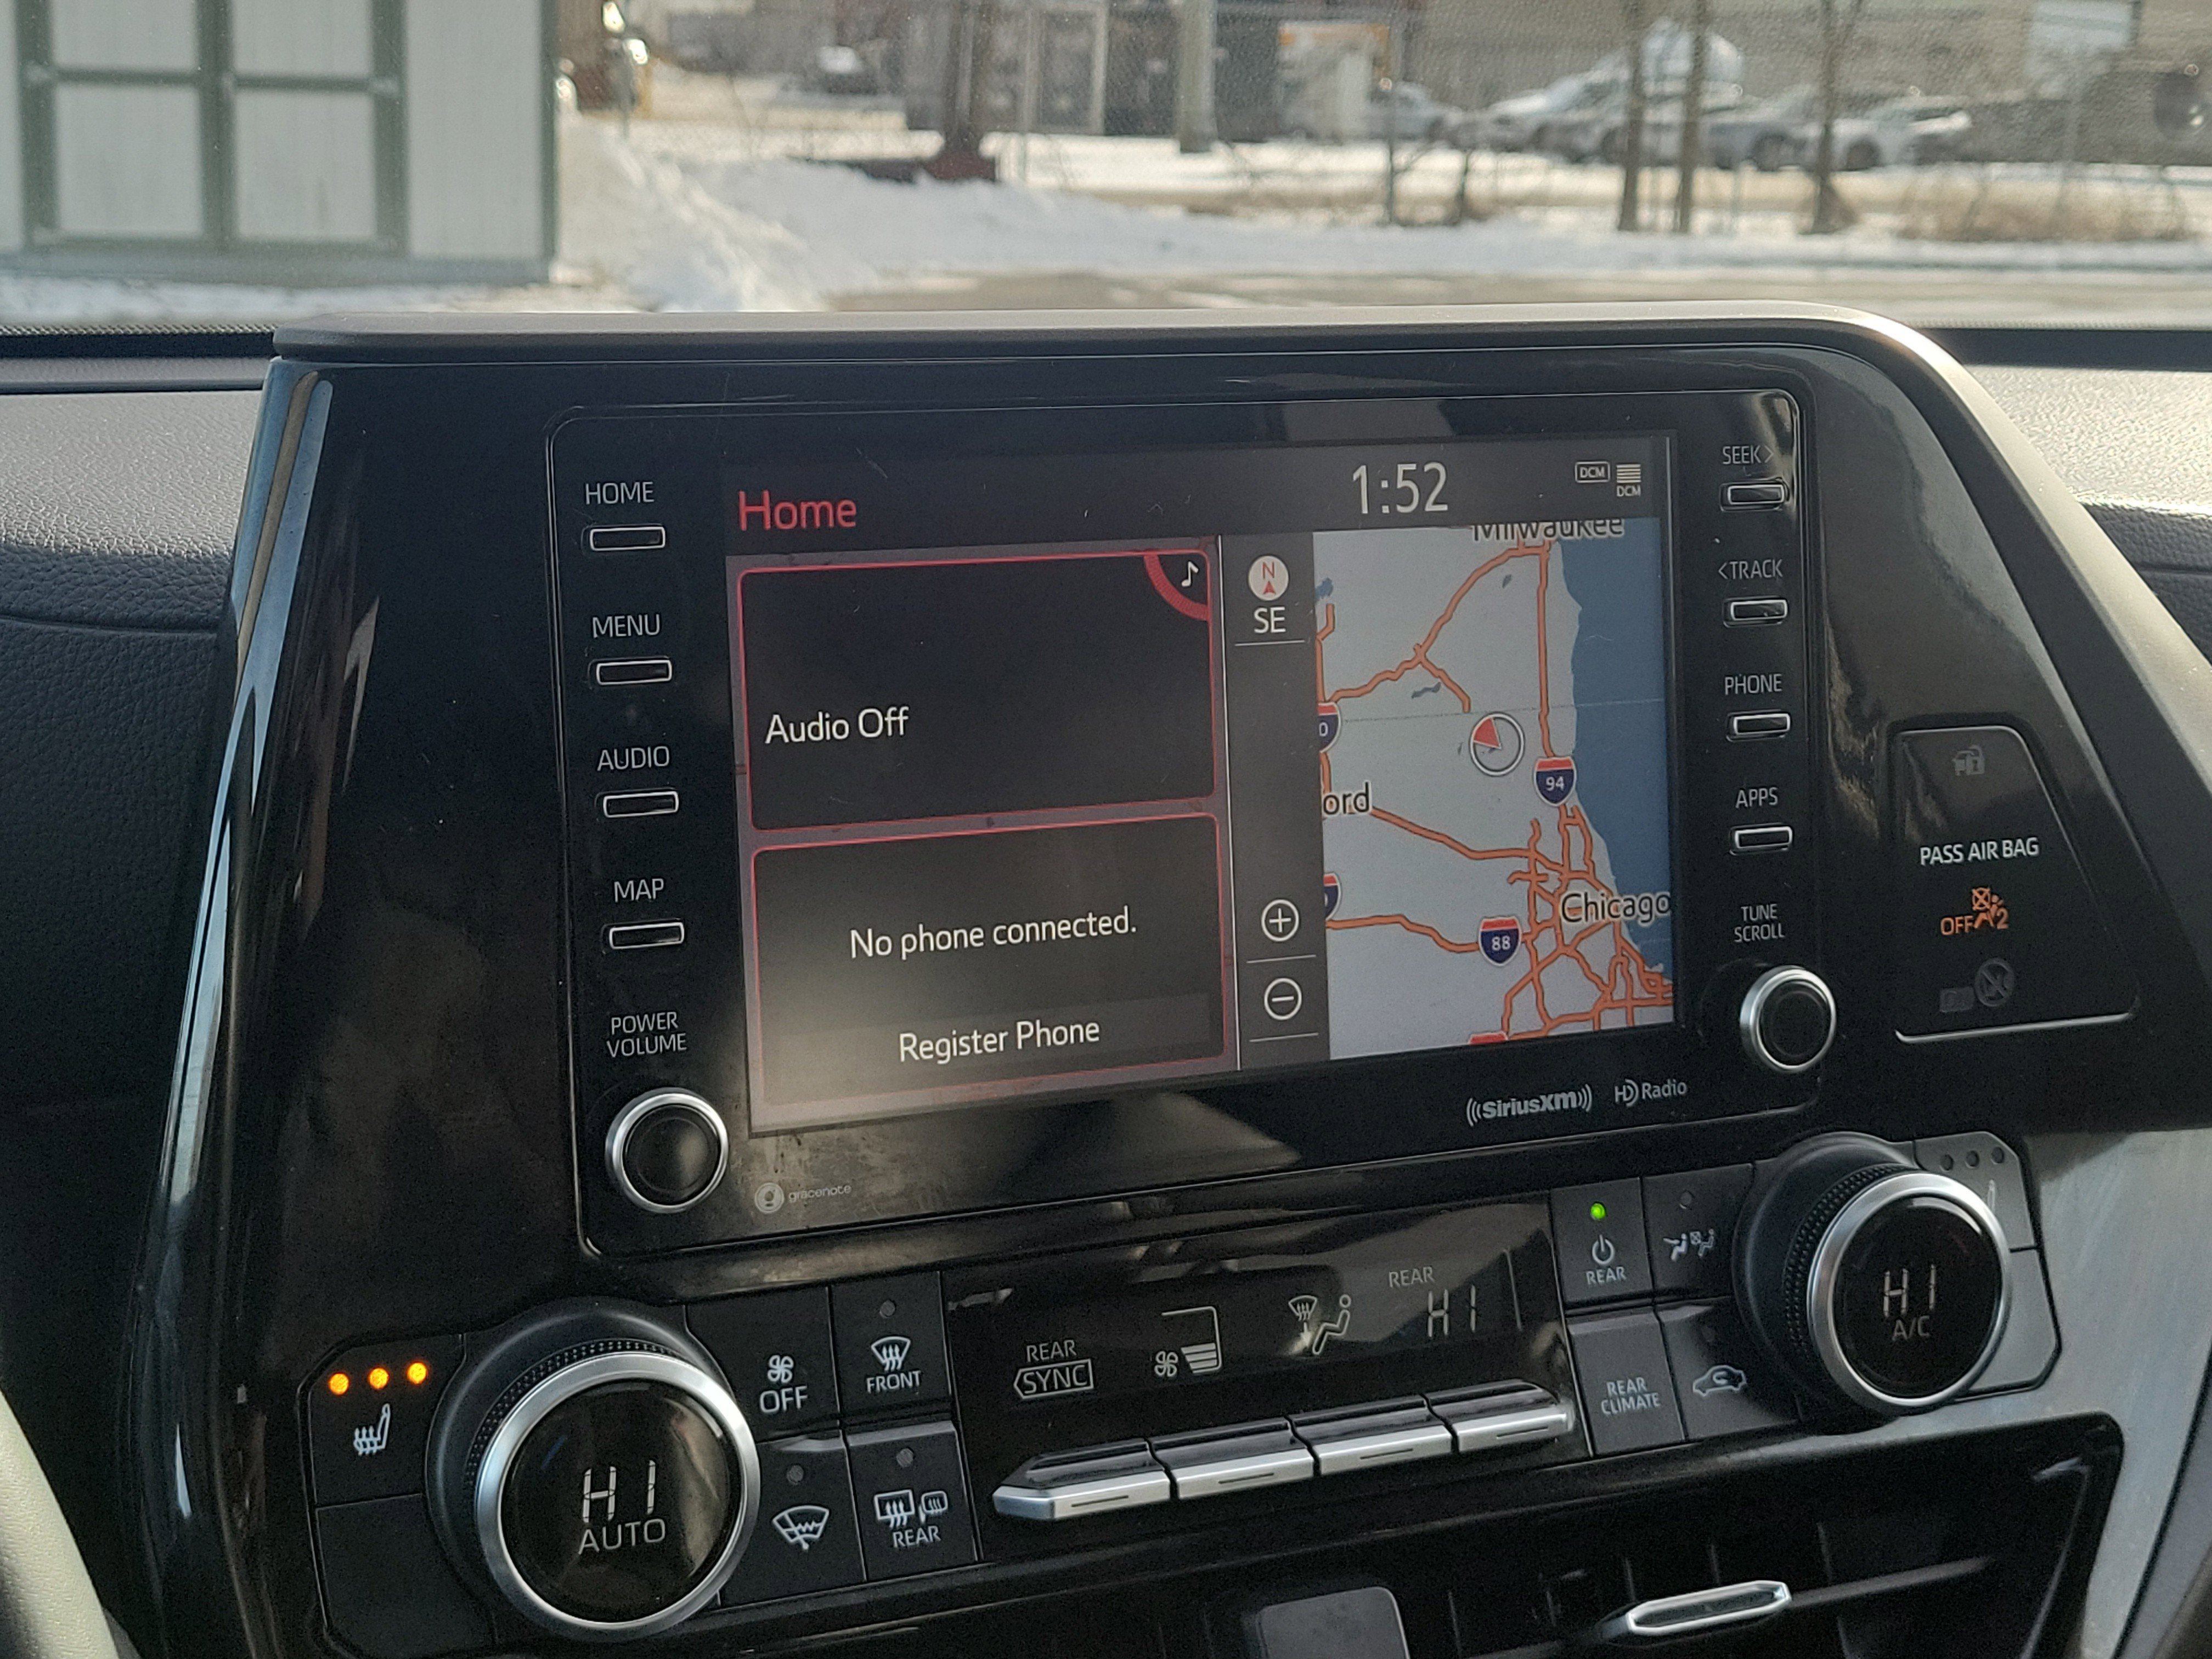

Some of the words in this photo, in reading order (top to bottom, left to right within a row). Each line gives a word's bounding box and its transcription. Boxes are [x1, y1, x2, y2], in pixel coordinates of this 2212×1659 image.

[1579, 467, 1606, 478] DCM
[585, 481, 654, 505] HOME
[1352, 460, 1449, 516] 1:52
[1616, 484, 1641, 497] DCM
[738, 489, 858, 531] Home
[1262, 561, 1275, 579] N
[592, 614, 661, 639] MENU
[1254, 606, 1286, 634] SE
[1724, 674, 1782, 695] PHONE
[765, 712, 850, 744] Audio
[857, 706, 910, 737] Off
[597, 746, 670, 771] AUDIO
[1545, 777, 1565, 792] 94
[1735, 787, 1779, 809] APPS
[1920, 844, 1964, 865] PASS
[1967, 841, 1999, 861] AIR
[2002, 837, 2040, 857] BAG
[613, 877, 665, 903] MAP
[1561, 891, 1671, 927] Chicago
[1741, 904, 1778, 921] TUNE
[850, 929, 893, 959] No
[901, 923, 984, 961] phone
[992, 905, 1137, 945] connected.
[1734, 924, 1785, 944] SCROLL
[1940, 915, 1974, 935] OFF
[1491, 936, 1511, 951] 88
[611, 1011, 679, 1035] POWER
[606, 1032, 688, 1058] VOLUME
[898, 1029, 1009, 1065] Register
[1016, 1020, 1101, 1050] Phone
[1614, 1078, 1639, 1107] HD
[1641, 1079, 1688, 1100] Radio
[788, 1184, 851, 1204] gracenote
[1388, 1266, 1435, 1288] REAR
[1585, 1265, 1627, 1285] REAR
[1891, 1315, 1932, 1342] A/C
[1025, 1339, 1077, 1363] REAR
[866, 1369, 922, 1392] FRONT
[1022, 1363, 1090, 1395] SYNC
[1606, 1377, 1647, 1397] REAR
[759, 1385, 808, 1414] OFF
[1600, 1392, 1660, 1415] CLIMATE
[578, 1518, 667, 1555] AUTO
[892, 1525, 941, 1548] REAR
